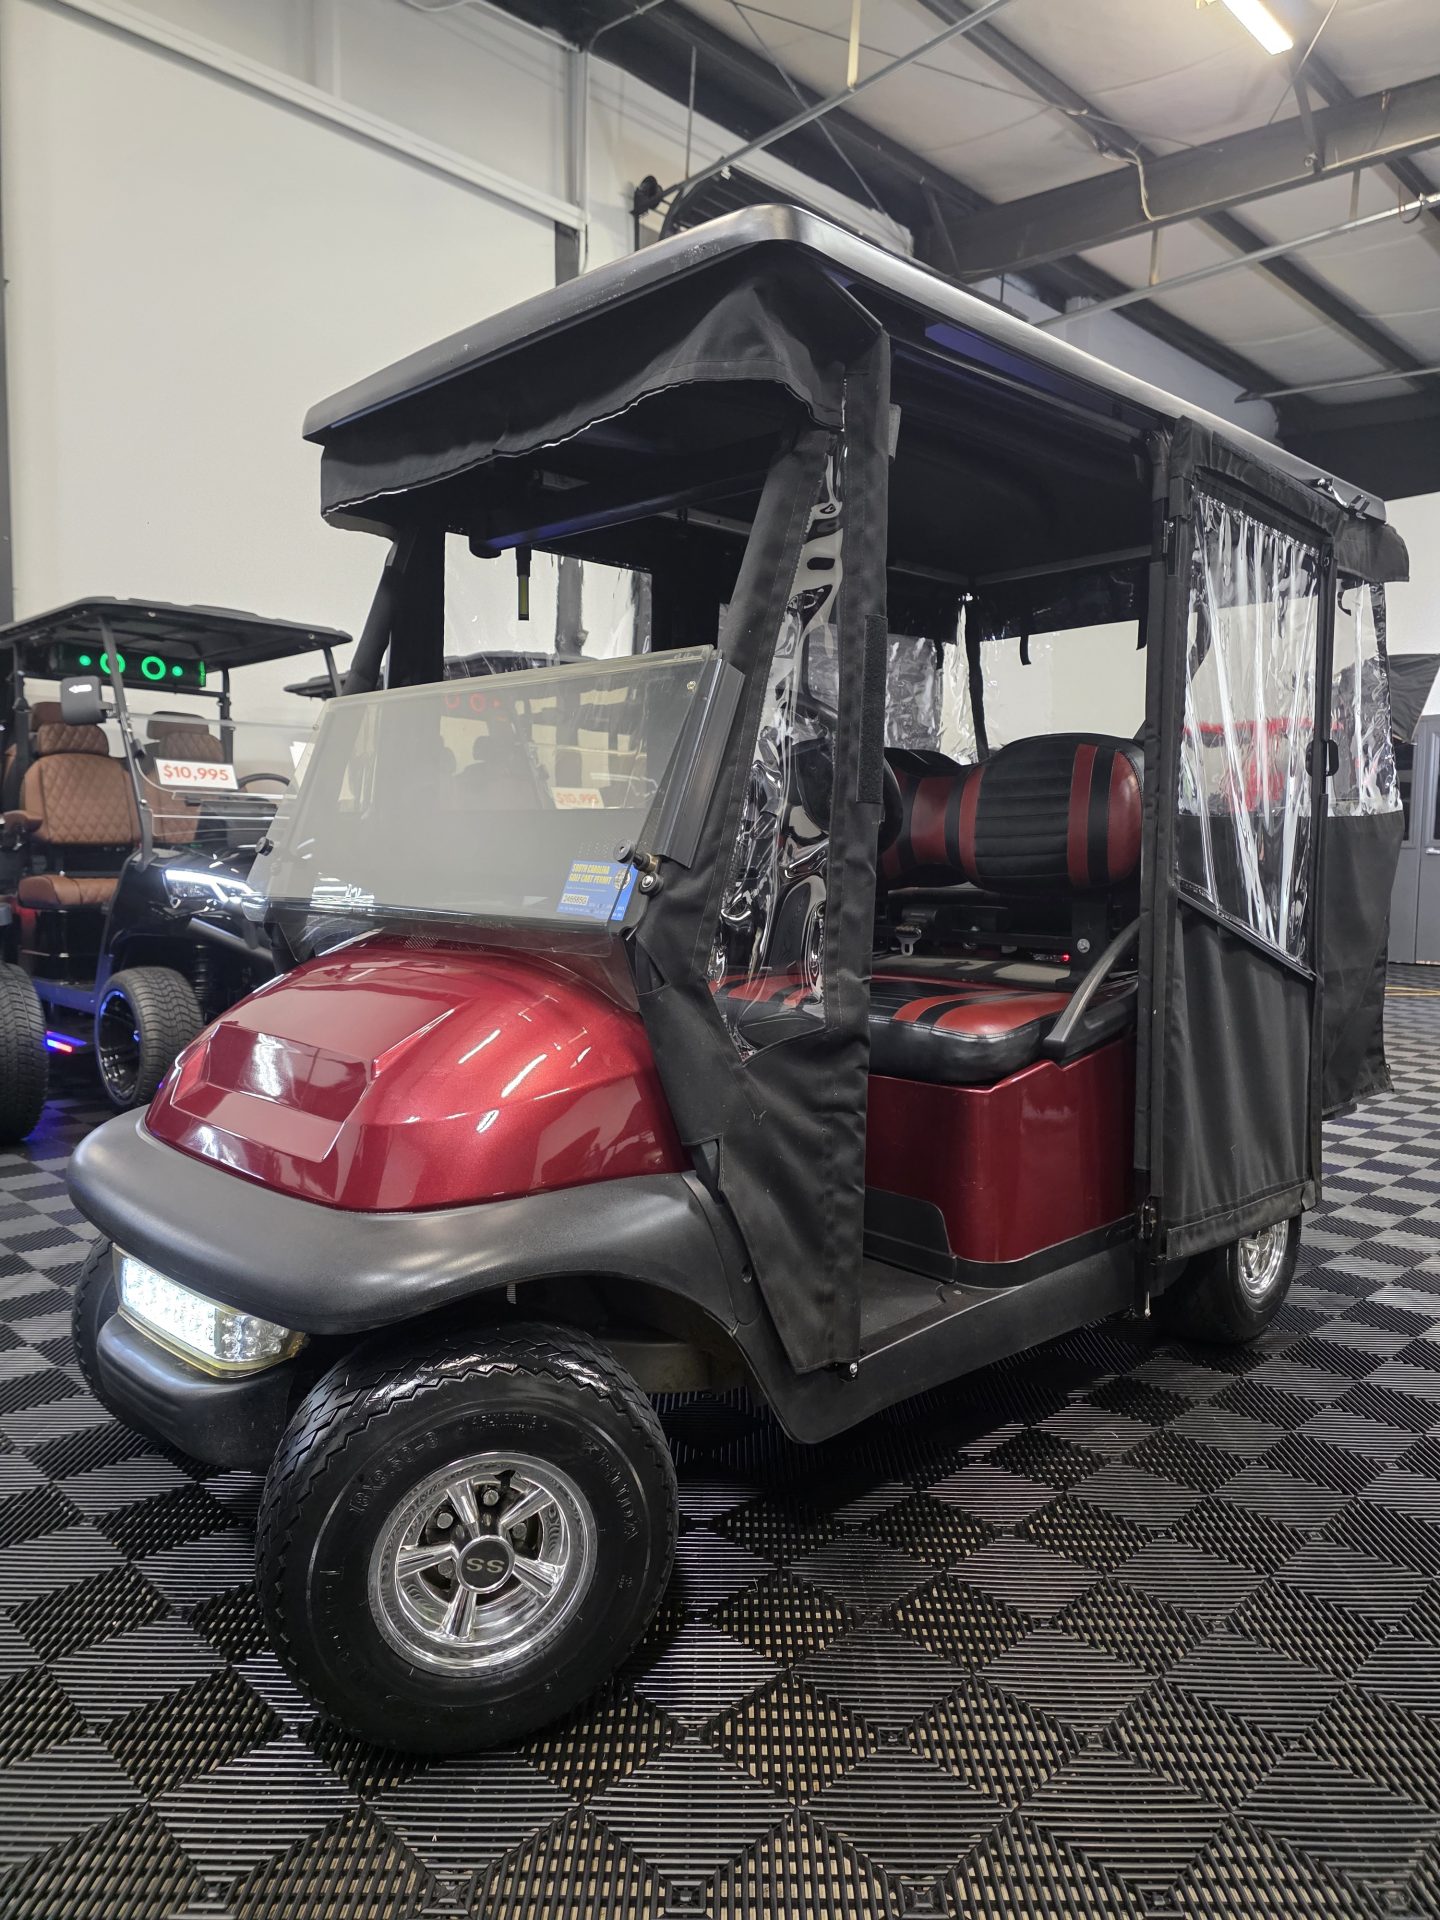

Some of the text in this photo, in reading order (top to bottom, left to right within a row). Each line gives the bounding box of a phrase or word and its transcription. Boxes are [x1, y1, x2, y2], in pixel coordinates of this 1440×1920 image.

[163, 764, 229, 782] $10,995
[572, 863, 610, 875] SOUTH CAROLINA
[568, 873, 612, 885] GOLF CART PERMIT
[466, 1557, 505, 1574] SS
